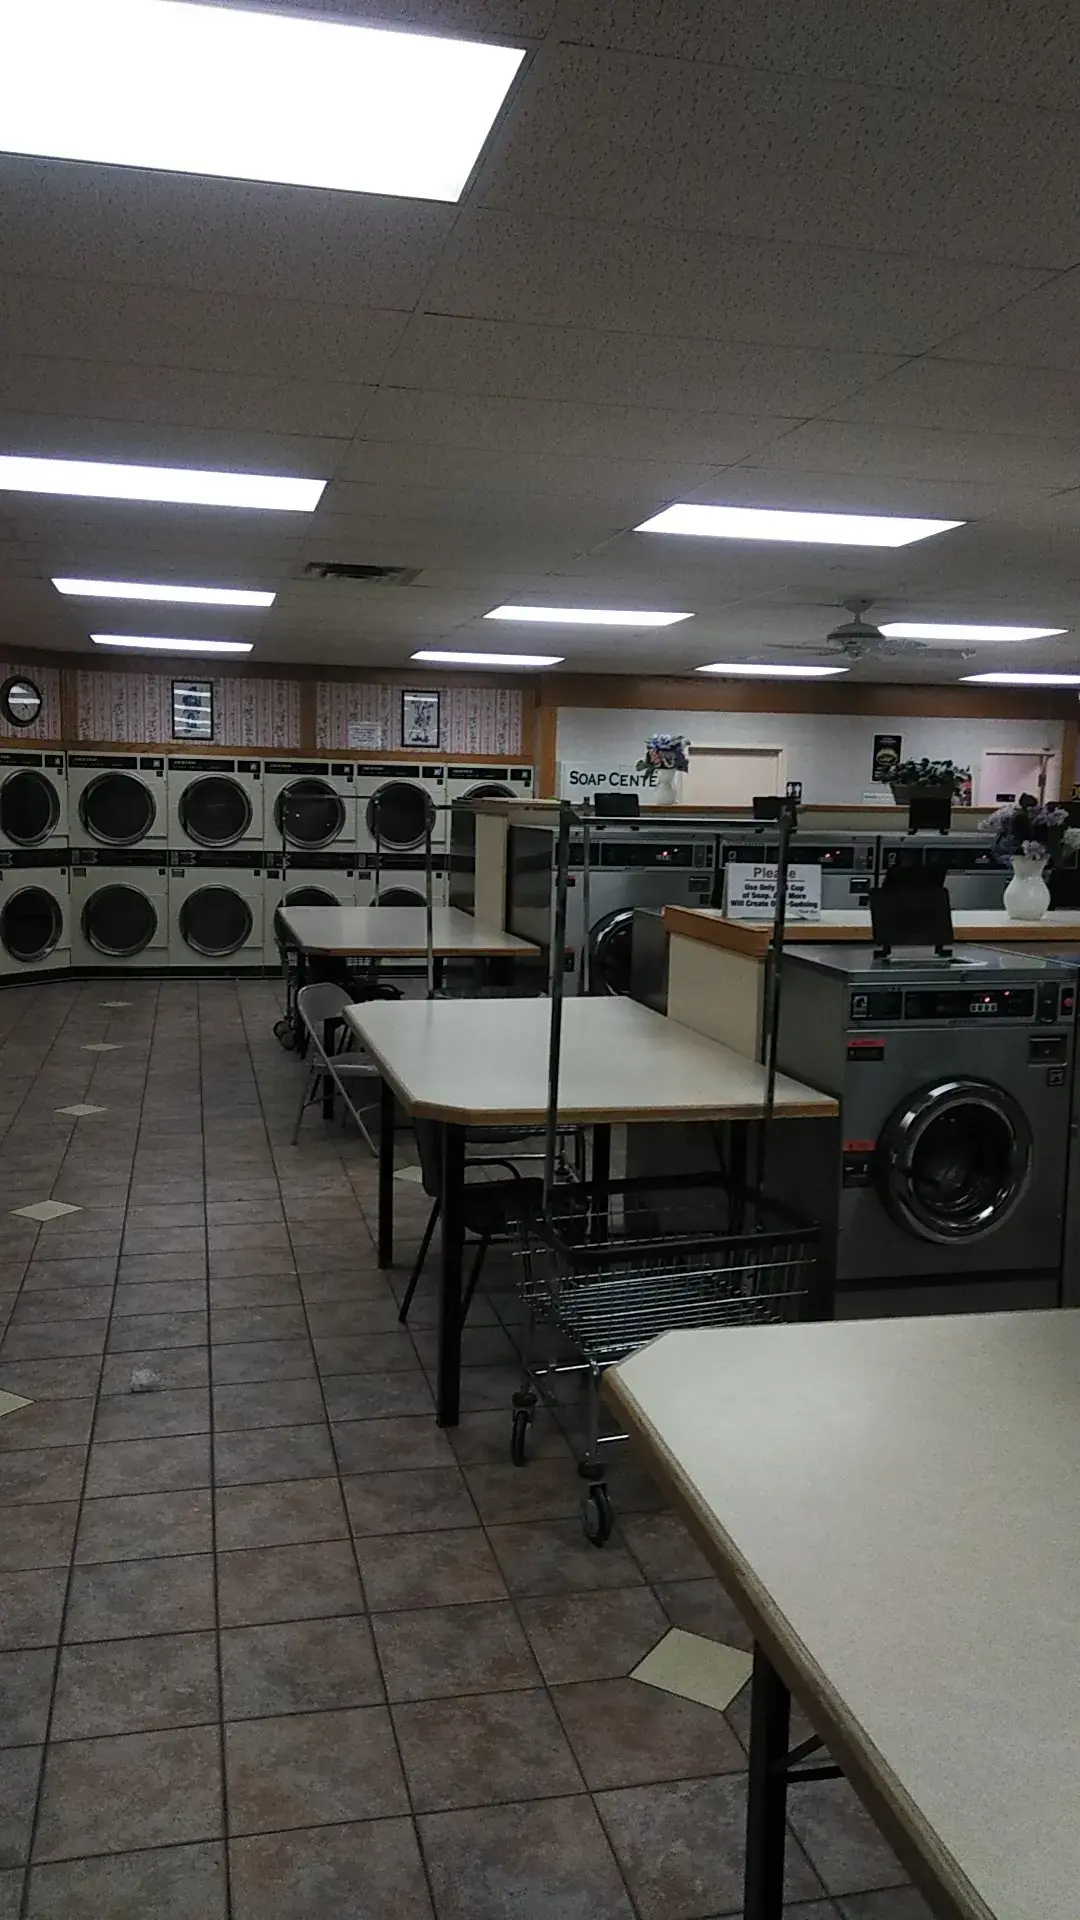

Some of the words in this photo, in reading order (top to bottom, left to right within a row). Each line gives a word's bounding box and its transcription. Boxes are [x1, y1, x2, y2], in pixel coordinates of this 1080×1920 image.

[570, 770, 606, 785] SOAP
[609, 772, 657, 787] CENTE
[753, 867, 796, 878] Pleae
[759, 884, 775, 892] Only
[791, 884, 804, 892] Cup
